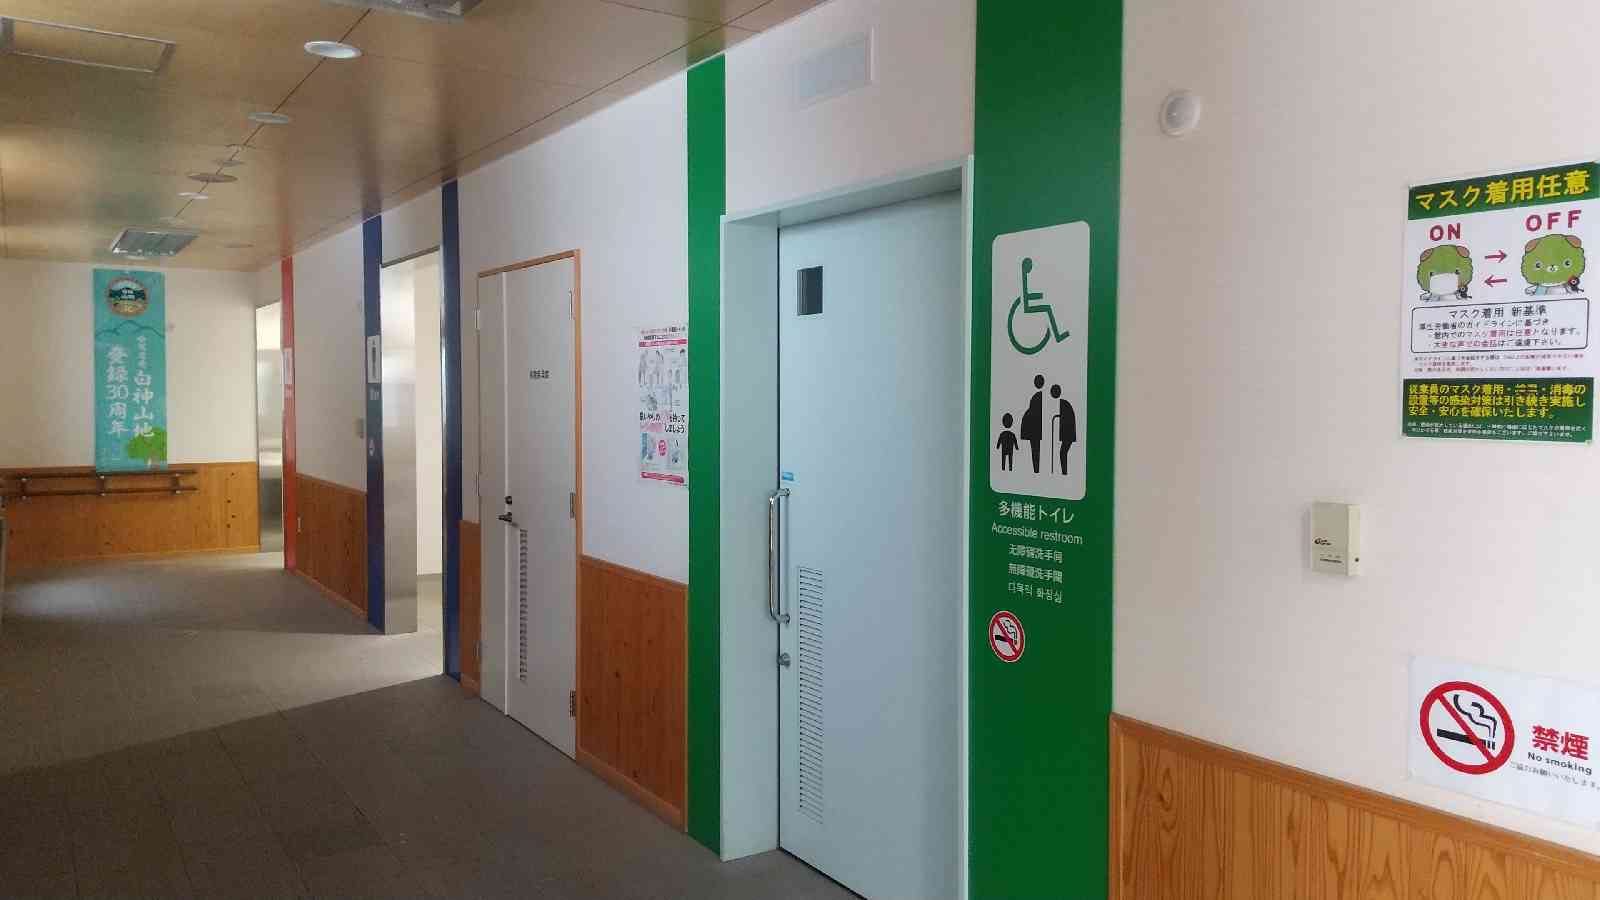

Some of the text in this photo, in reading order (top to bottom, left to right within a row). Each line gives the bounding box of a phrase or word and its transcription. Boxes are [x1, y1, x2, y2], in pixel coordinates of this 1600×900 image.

[1415, 169, 1591, 212] マスク着用任意
[1429, 222, 1461, 241] ON
[1525, 209, 1582, 232] OFF
[1448, 306, 1504, 319] マスク着用
[132, 369, 155, 437] 白神山地
[998, 501, 1075, 524] 多機能トイレ
[991, 521, 1083, 545] Accessible restroom
[1531, 724, 1590, 761] 禁煙
[1527, 751, 1593, 776] No smoking
